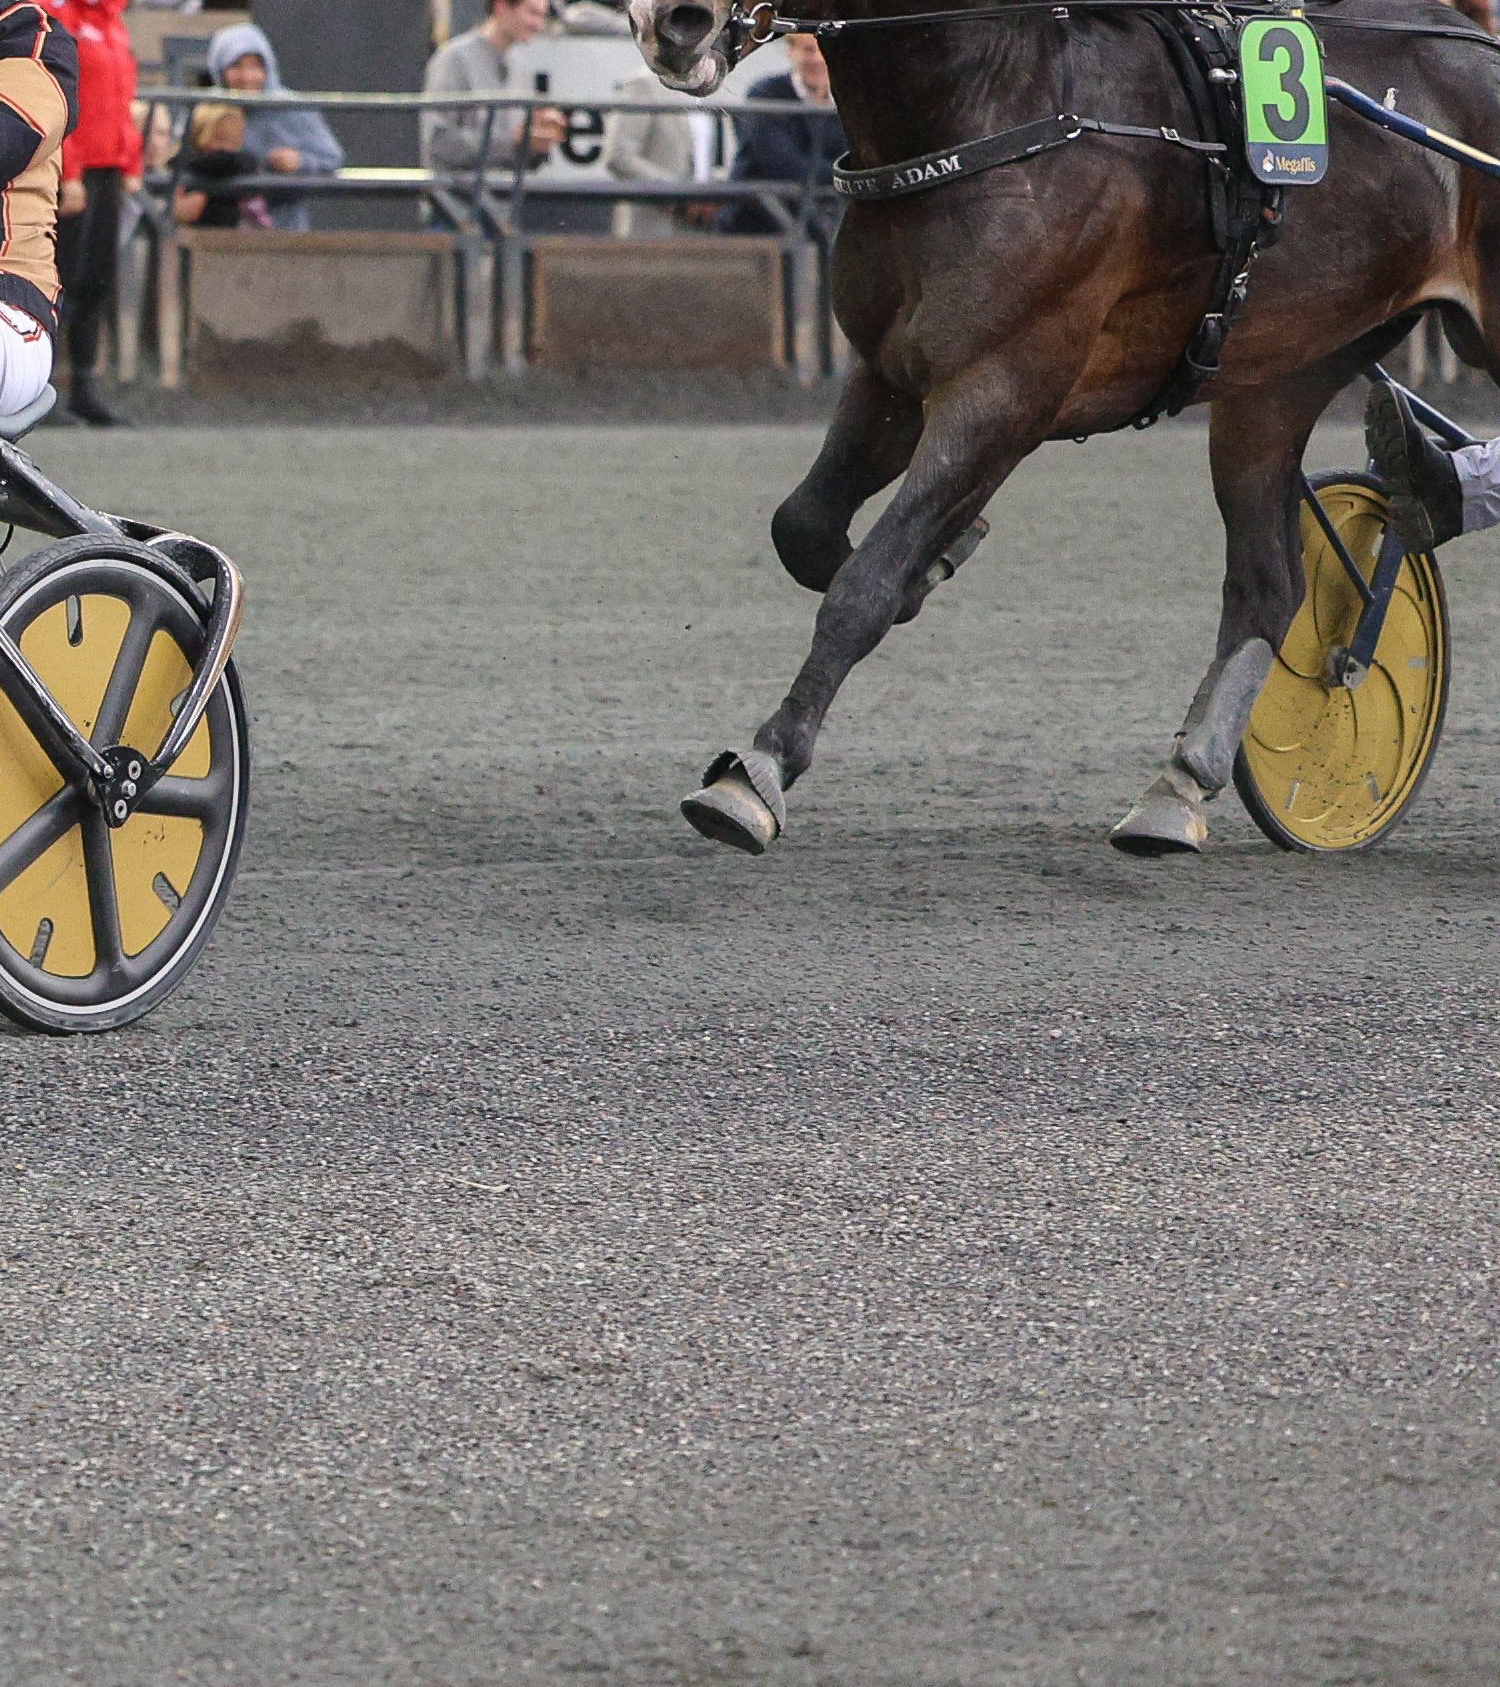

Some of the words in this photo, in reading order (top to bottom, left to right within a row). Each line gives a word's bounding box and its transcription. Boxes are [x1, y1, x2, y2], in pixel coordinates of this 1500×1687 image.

[1258, 27, 1310, 142] 3
[891, 154, 963, 189] ADAM
[1275, 155, 1317, 176] Megaflis
